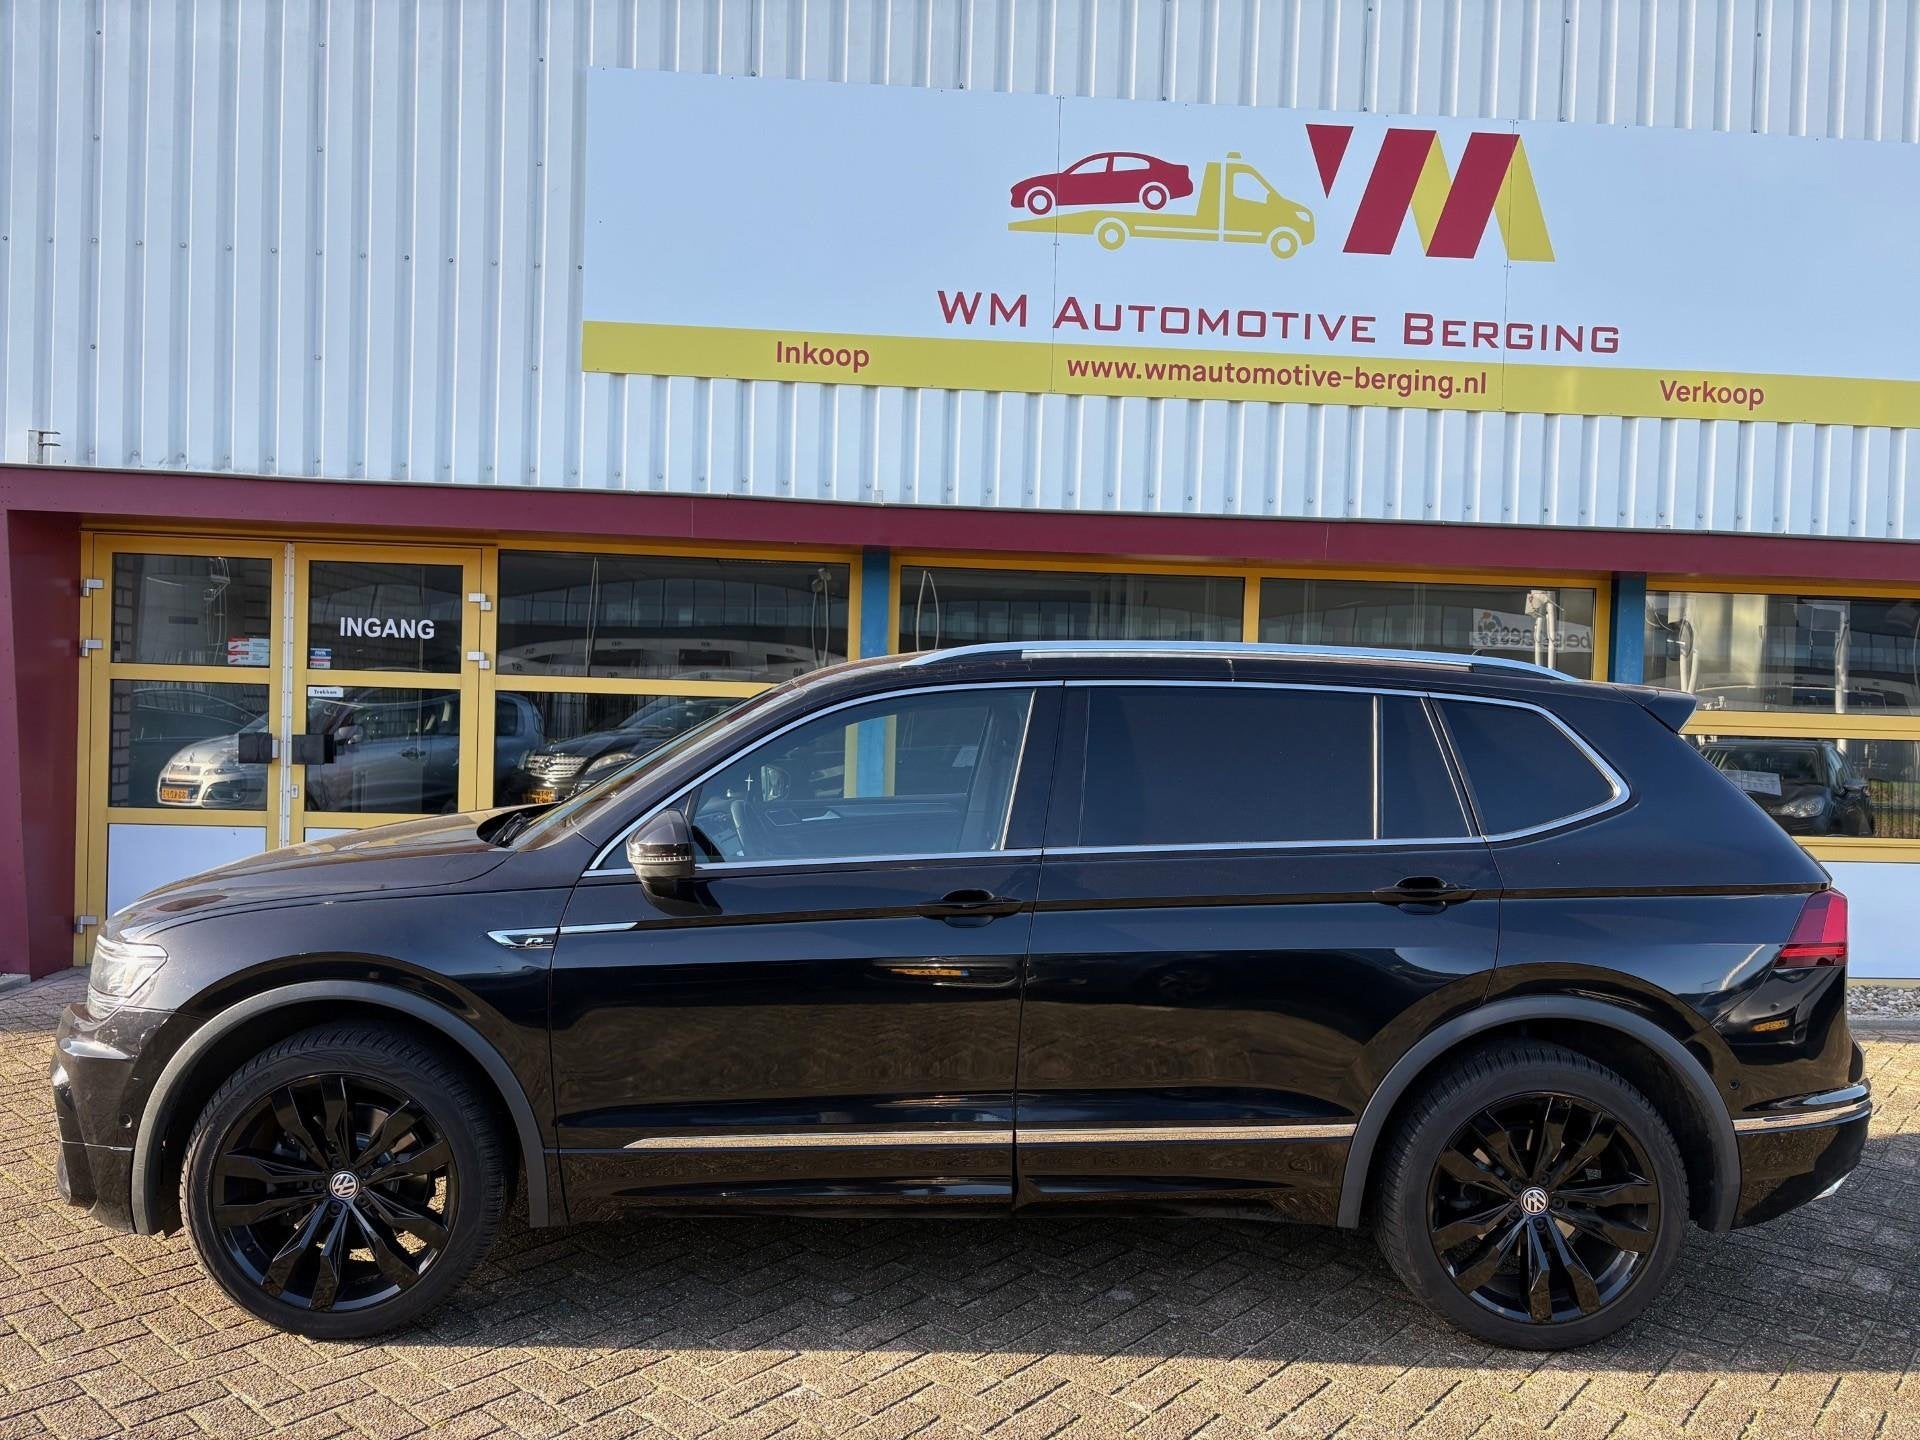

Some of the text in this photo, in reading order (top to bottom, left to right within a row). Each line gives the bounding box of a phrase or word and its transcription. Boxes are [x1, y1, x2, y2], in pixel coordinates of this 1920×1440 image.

[937, 290, 1028, 328] WM
[776, 341, 870, 373] Inkoop
[1067, 356, 1488, 400] www.wmautomotive-berging.nl
[1659, 379, 1765, 411] Verkoop
[339, 616, 436, 640] INGANG
